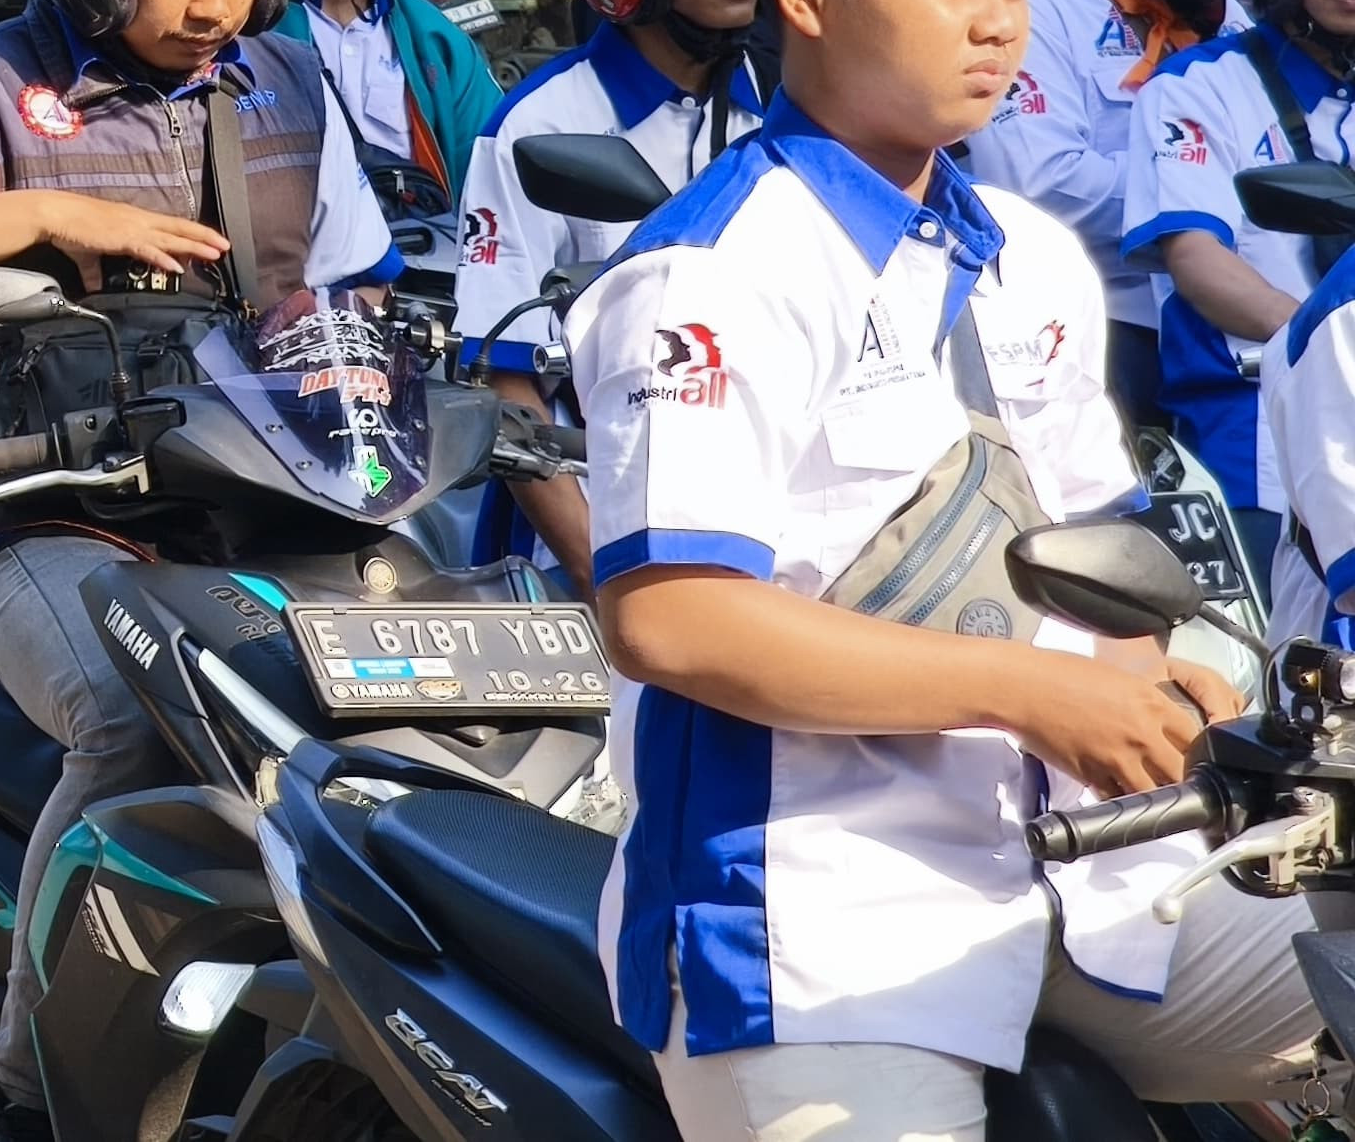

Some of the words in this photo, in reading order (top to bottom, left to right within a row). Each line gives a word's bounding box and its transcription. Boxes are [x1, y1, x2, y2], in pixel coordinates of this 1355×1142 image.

[301, 368, 388, 396] DAYTONA
[1167, 503, 1217, 544] JC
[103, 598, 161, 671] YAMAHA
[310, 619, 348, 656] E
[371, 619, 481, 656] 6787
[499, 619, 591, 656] YBD
[349, 682, 413, 698] YAMAHA
